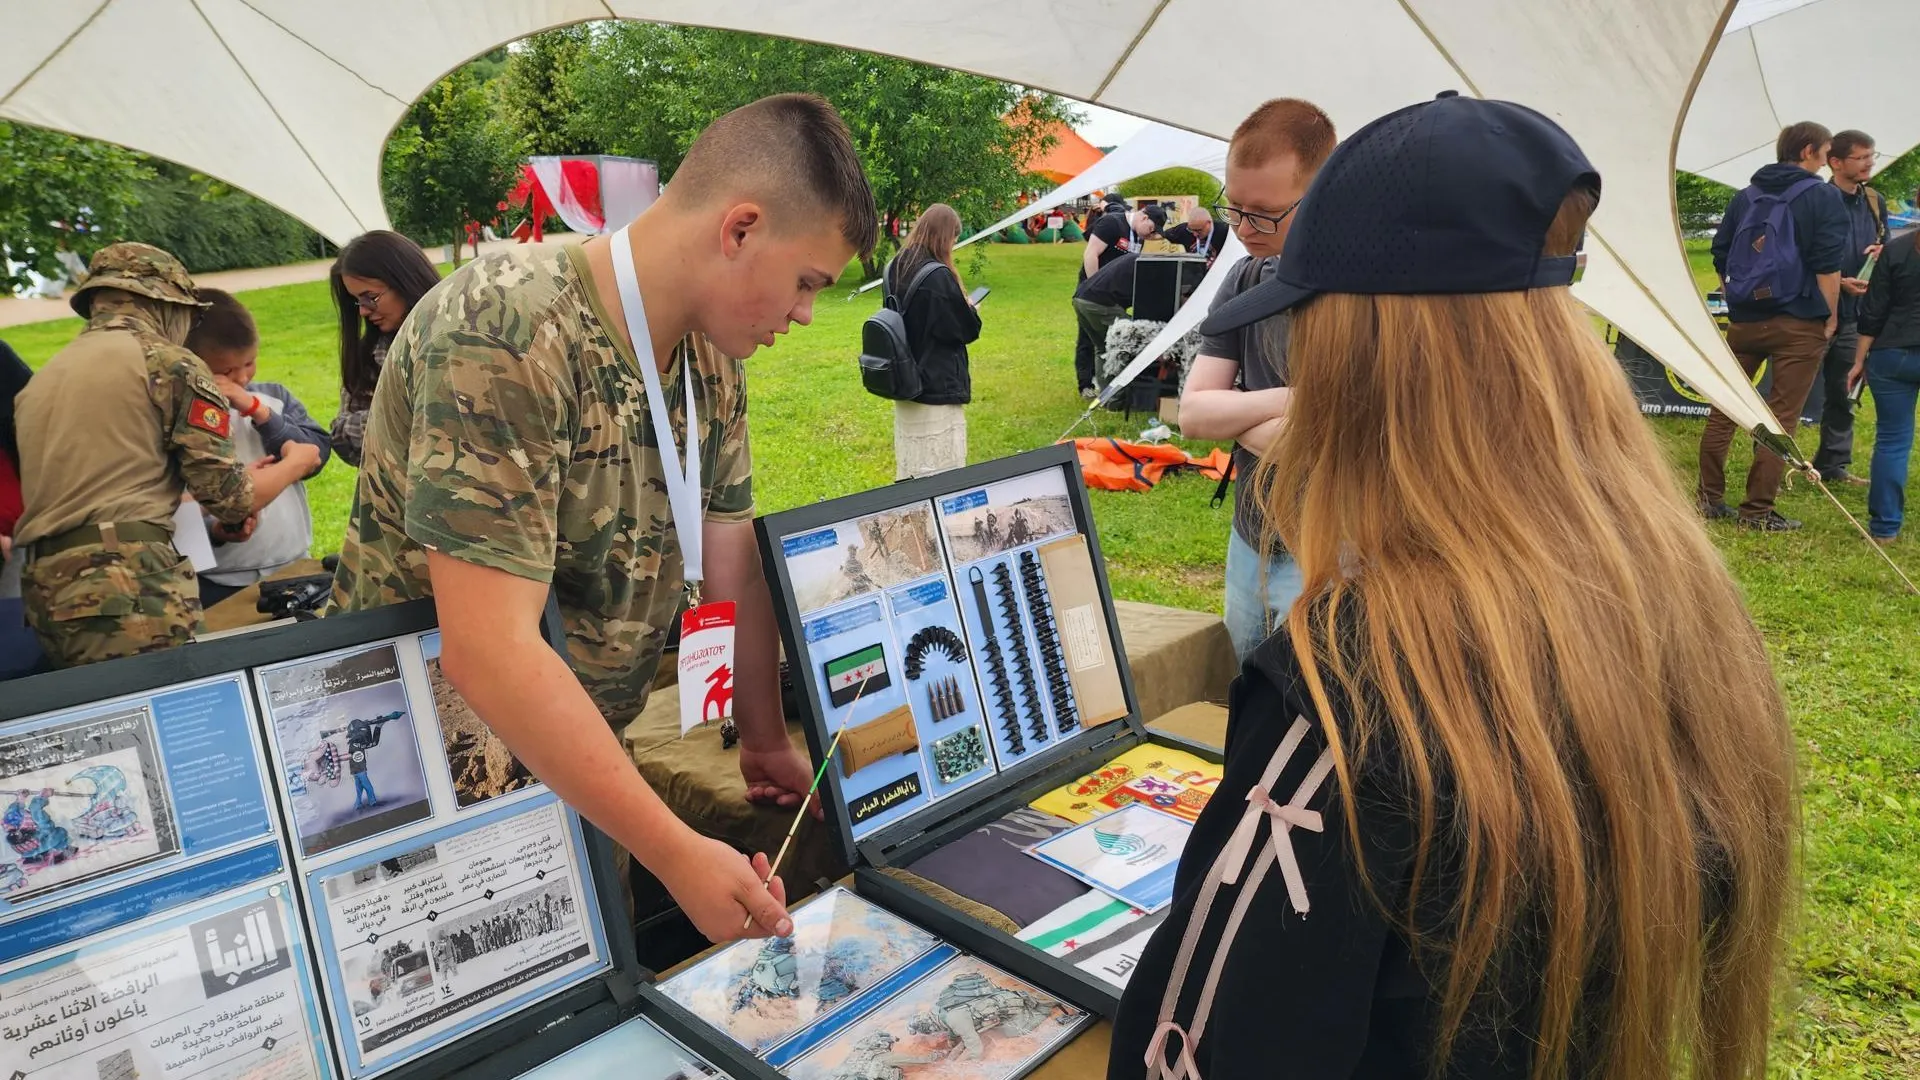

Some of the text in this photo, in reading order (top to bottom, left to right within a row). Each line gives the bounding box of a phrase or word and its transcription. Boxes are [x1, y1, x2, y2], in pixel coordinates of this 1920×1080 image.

[84, 726, 109, 742] داعش
[908, 781, 916, 793] يا
[856, 796, 880, 818] العباس
[508, 850, 538, 865] ومواجهات
[544, 853, 553, 864] في
[458, 873, 470, 884] على
[462, 869, 508, 893] النصارى في مصر
[402, 884, 418, 894] كبير
[425, 884, 440, 895] PKK
[369, 904, 392, 919] وتدمير
[401, 902, 417, 914] الرقة
[418, 899, 428, 911] في
[356, 915, 387, 934] في ديالى
[204, 909, 278, 986] النبأ
[101, 972, 160, 1004] الرافضة
[440, 984, 452, 994] ١٤
[2, 1012, 58, 1042] عشرية
[150, 990, 285, 1050] منطقة مشيرفة وحي الهرمات
[358, 1016, 371, 1028] ١٥
[28, 998, 148, 1060] يأكلون أوثانهم
[182, 1014, 262, 1051] ساحة حرب جديدة
[226, 1025, 262, 1048] الروافض
[199, 1042, 226, 1062] خسائر
[164, 1052, 198, 1072] جسيمة
